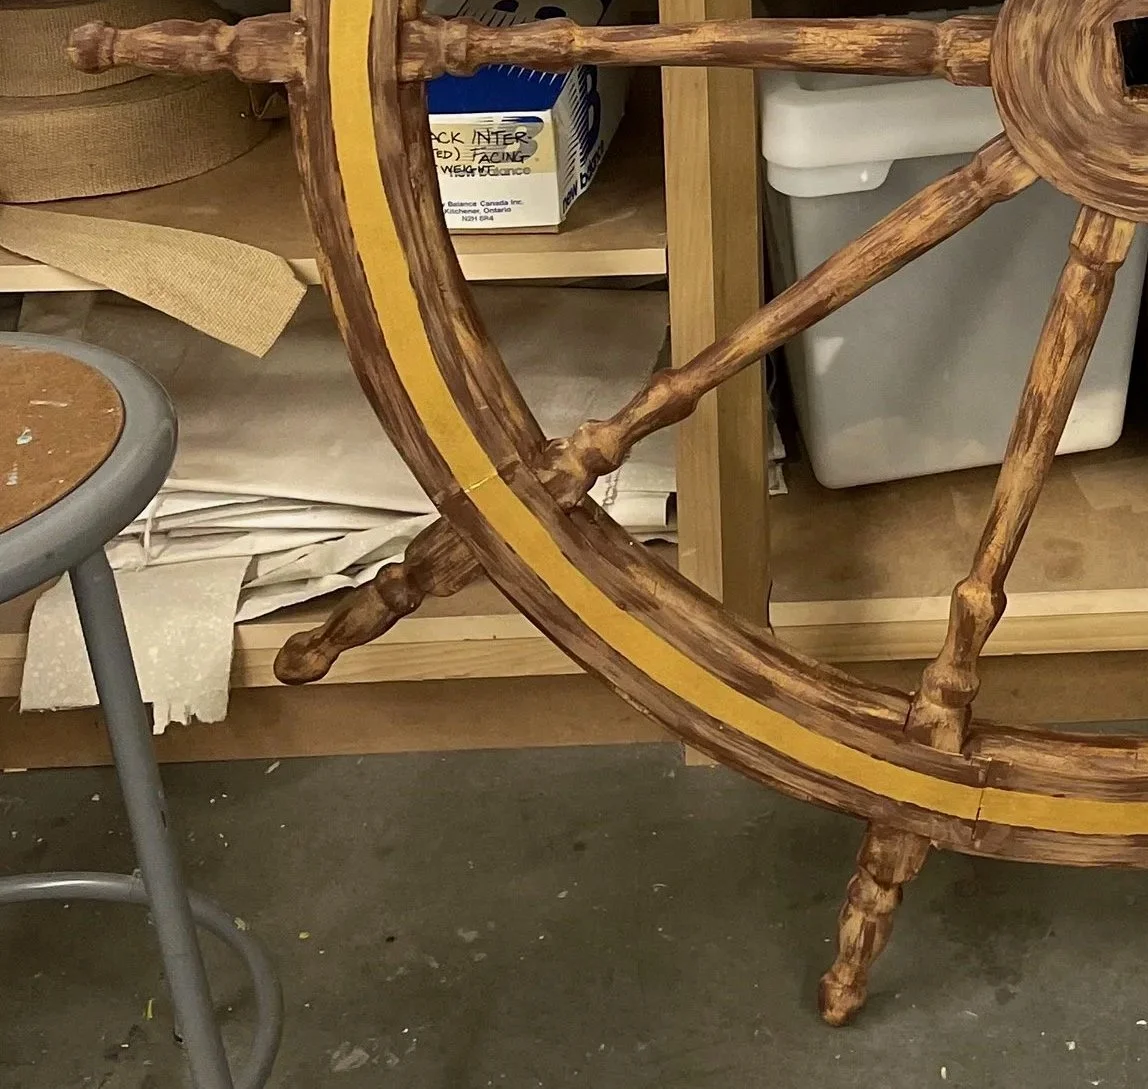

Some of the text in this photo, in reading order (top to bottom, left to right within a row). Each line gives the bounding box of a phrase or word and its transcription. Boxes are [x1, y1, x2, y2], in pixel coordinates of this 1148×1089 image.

[471, 128, 533, 145] INTER-
[470, 147, 531, 164] FACING
[480, 199, 509, 207] Canada
